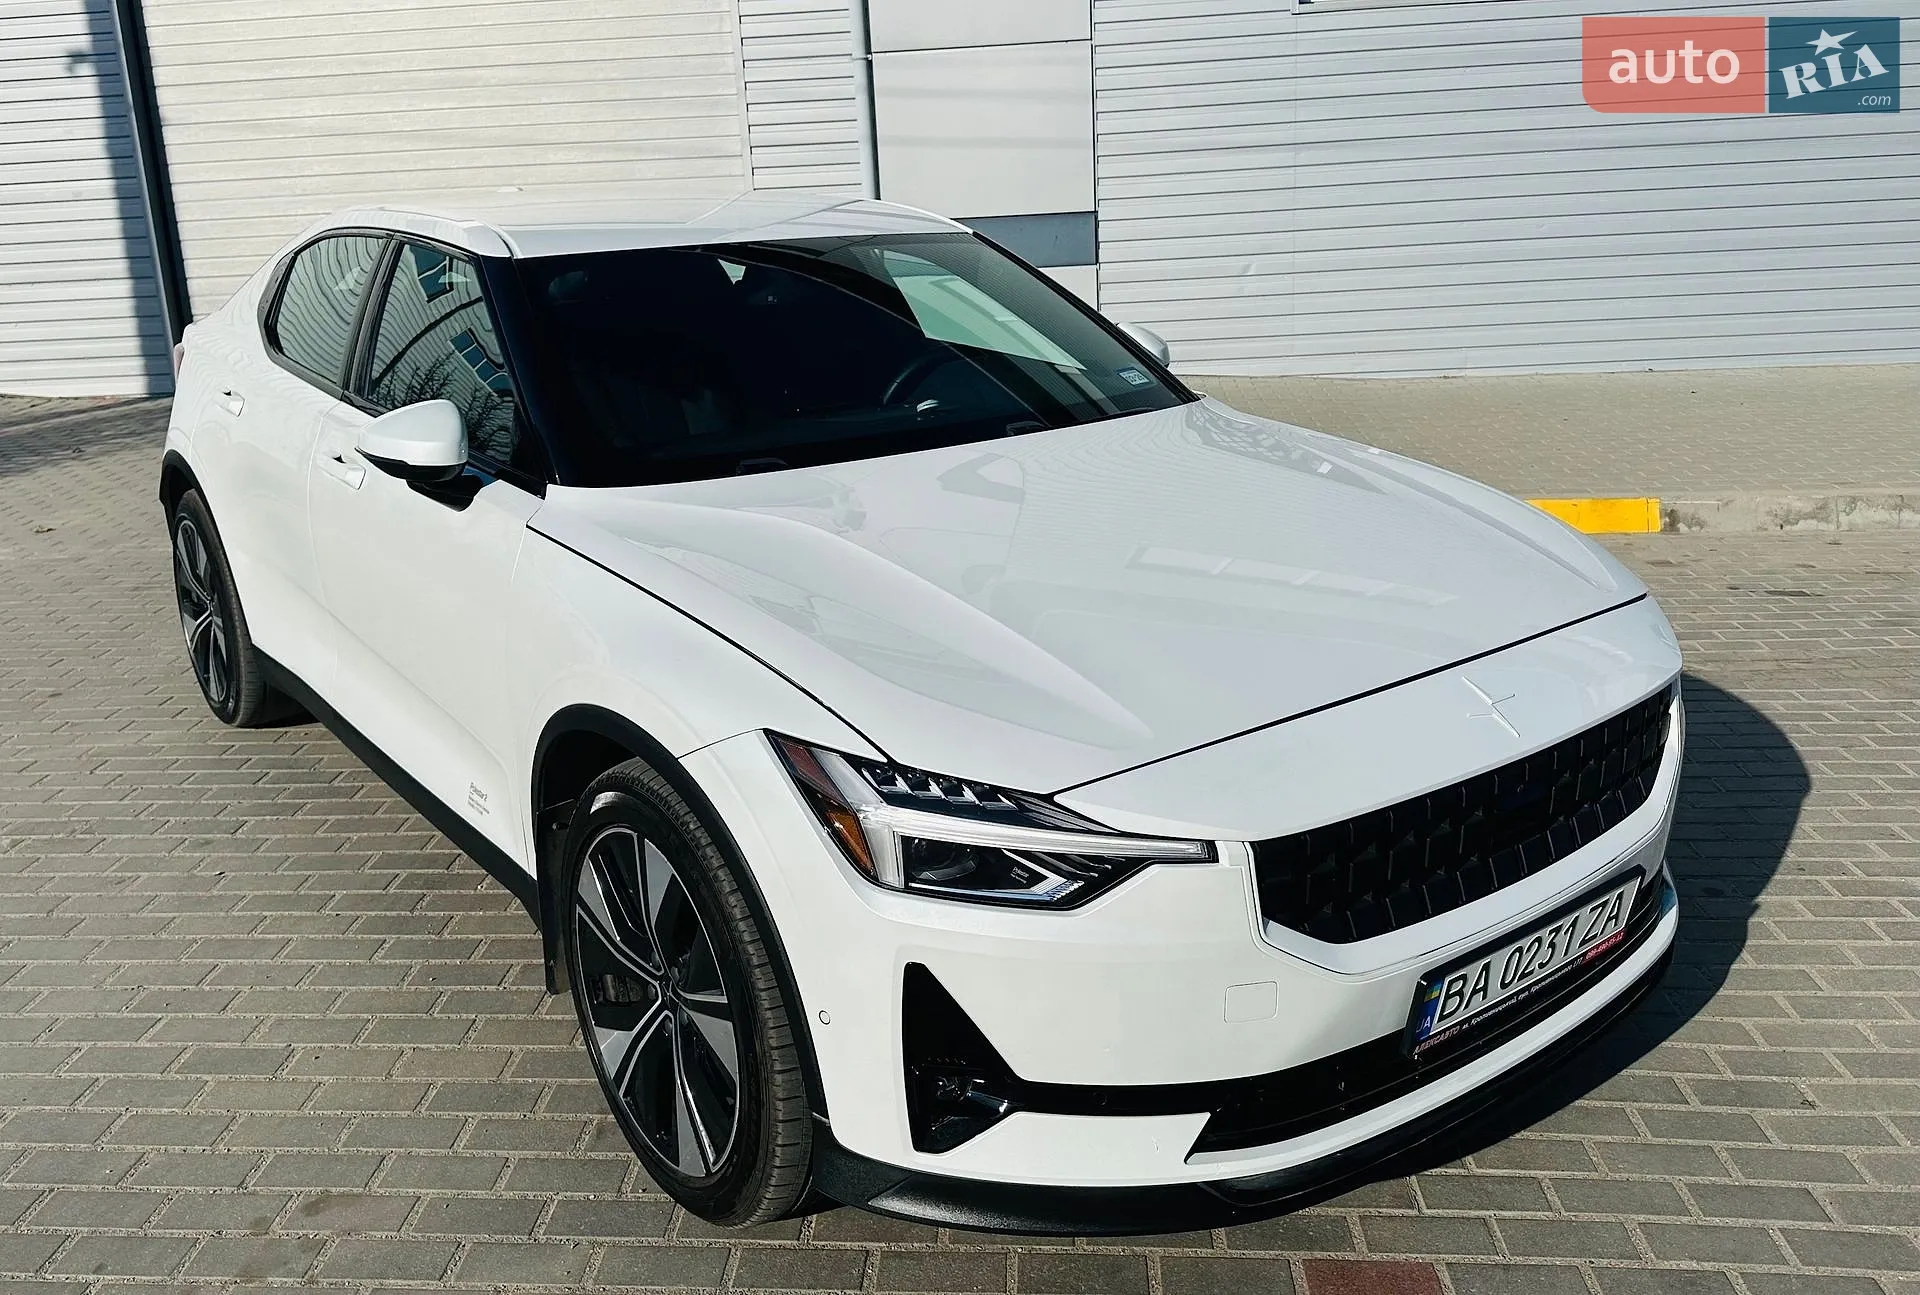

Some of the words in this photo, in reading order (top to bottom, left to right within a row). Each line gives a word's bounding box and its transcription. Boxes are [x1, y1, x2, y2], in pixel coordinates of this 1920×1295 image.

[1435, 958, 1491, 1025] BA
[1498, 912, 1580, 990] 0231
[1576, 889, 1624, 949] ZA
